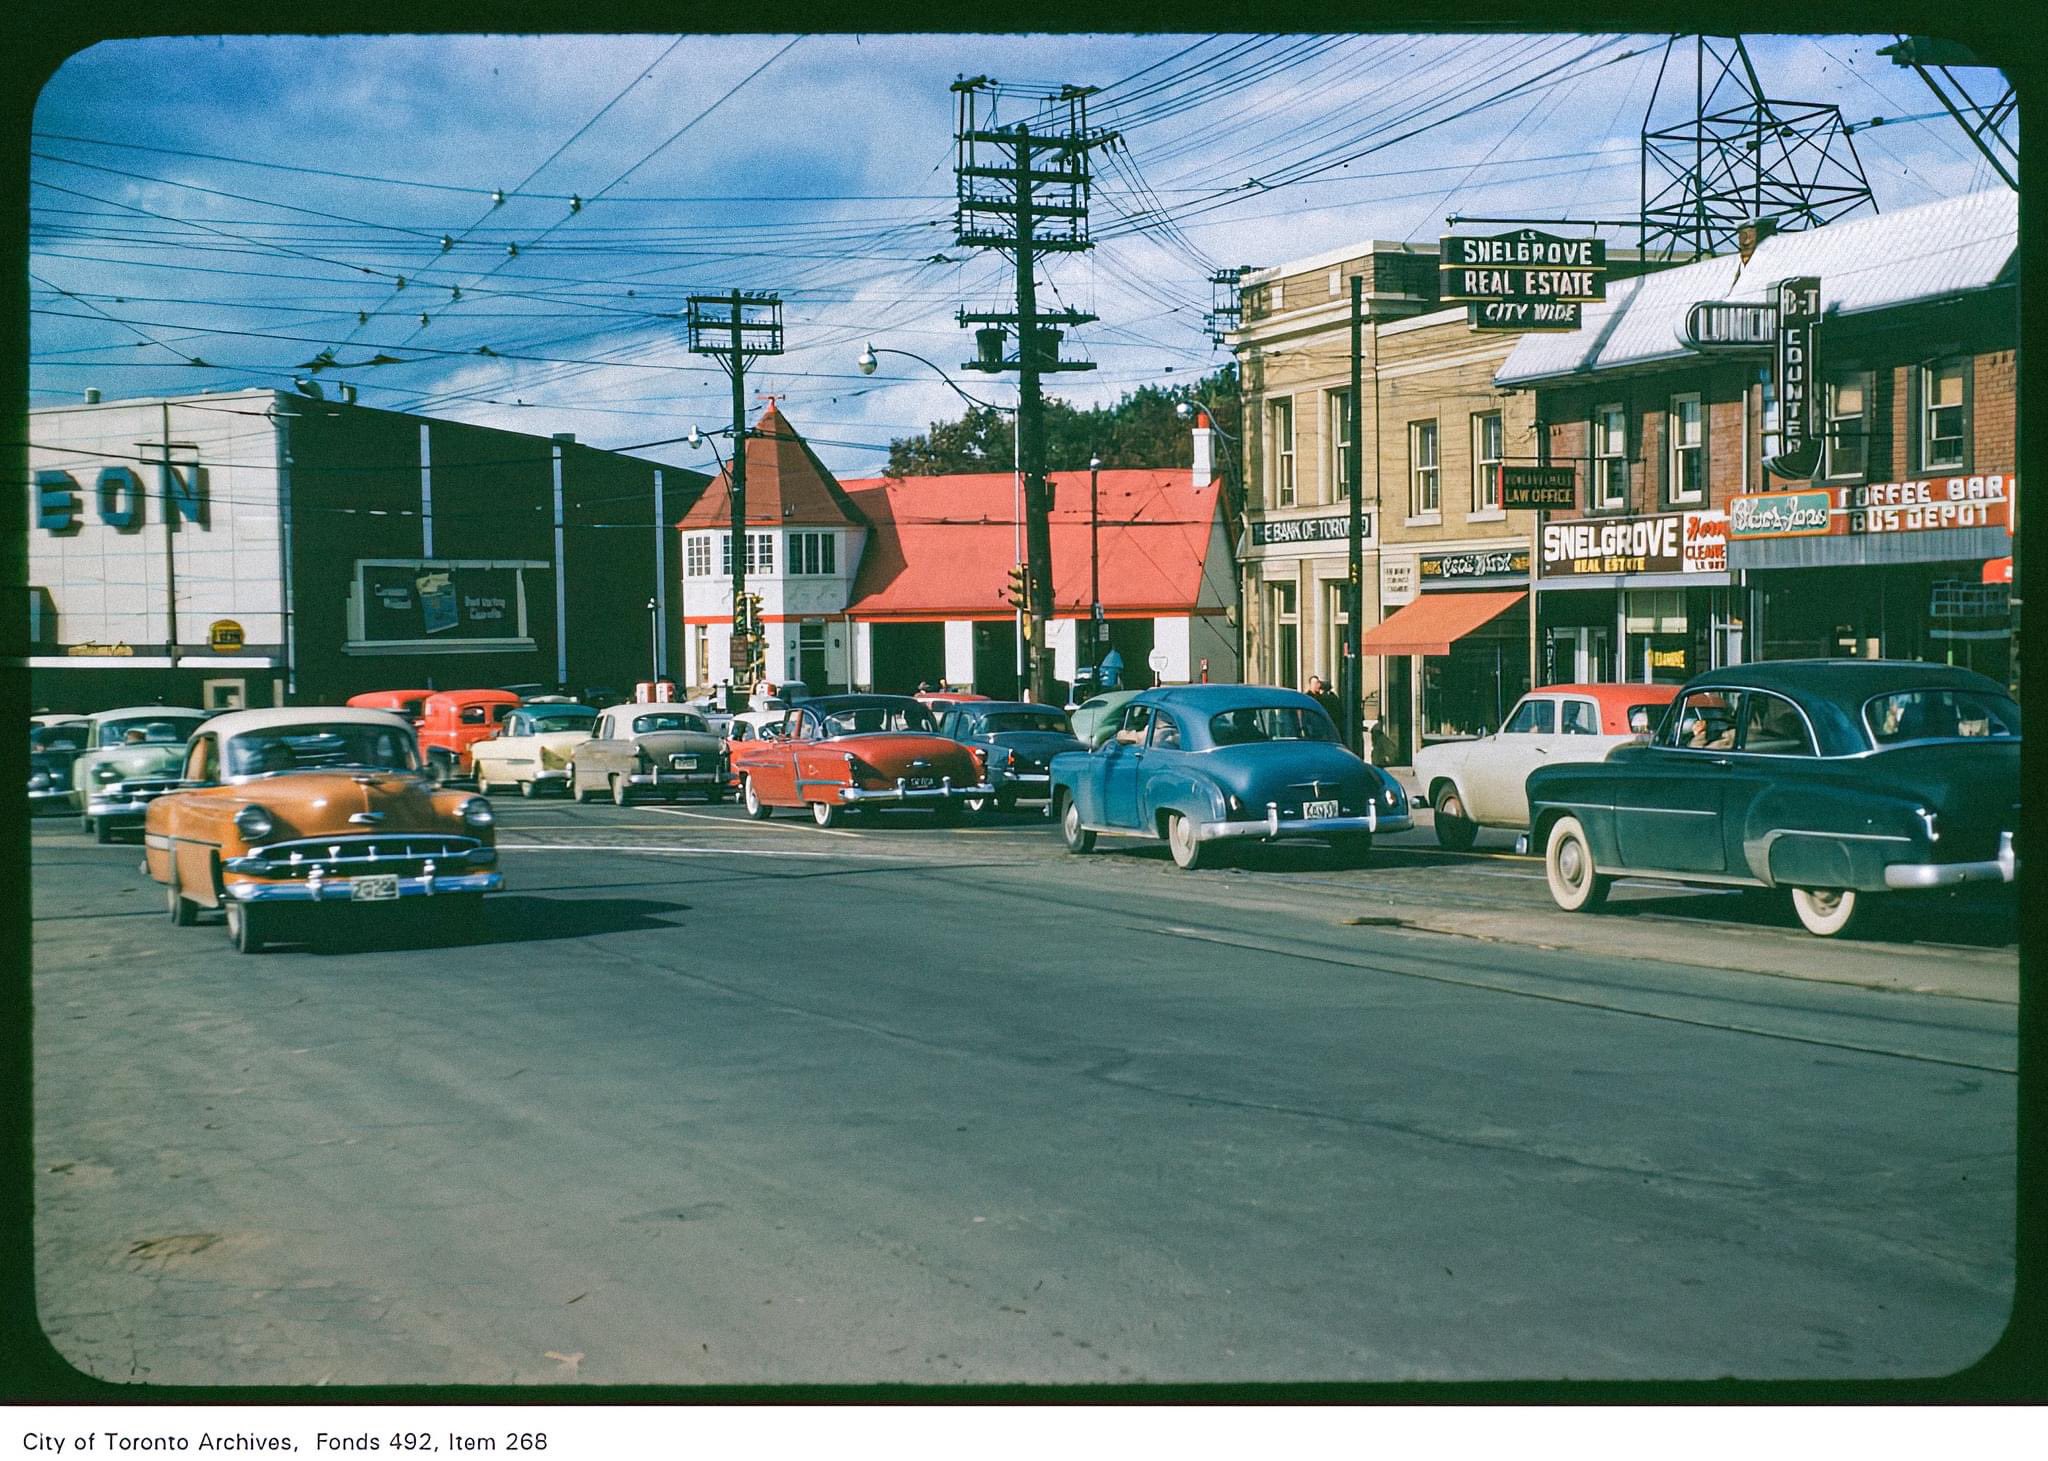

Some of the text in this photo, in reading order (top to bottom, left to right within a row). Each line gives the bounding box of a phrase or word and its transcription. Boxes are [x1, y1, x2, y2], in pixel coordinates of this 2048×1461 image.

[1463, 240, 1593, 265] SNELGROVE
[1464, 270, 1594, 296] REAL ESTATE
[1485, 303, 1577, 322] CITY WIDE
[34, 465, 201, 529] EON
[1505, 488, 1574, 503] LAW OFFICE
[1947, 475, 2003, 500] BAR
[1853, 508, 1900, 532] BUS
[1906, 501, 1989, 529] DEPOT
[1273, 521, 1302, 541] BANK
[1302, 520, 1318, 540] OF
[1544, 517, 1678, 562] SNELGROVE
[1574, 557, 1646, 573] REAL ESTATE
